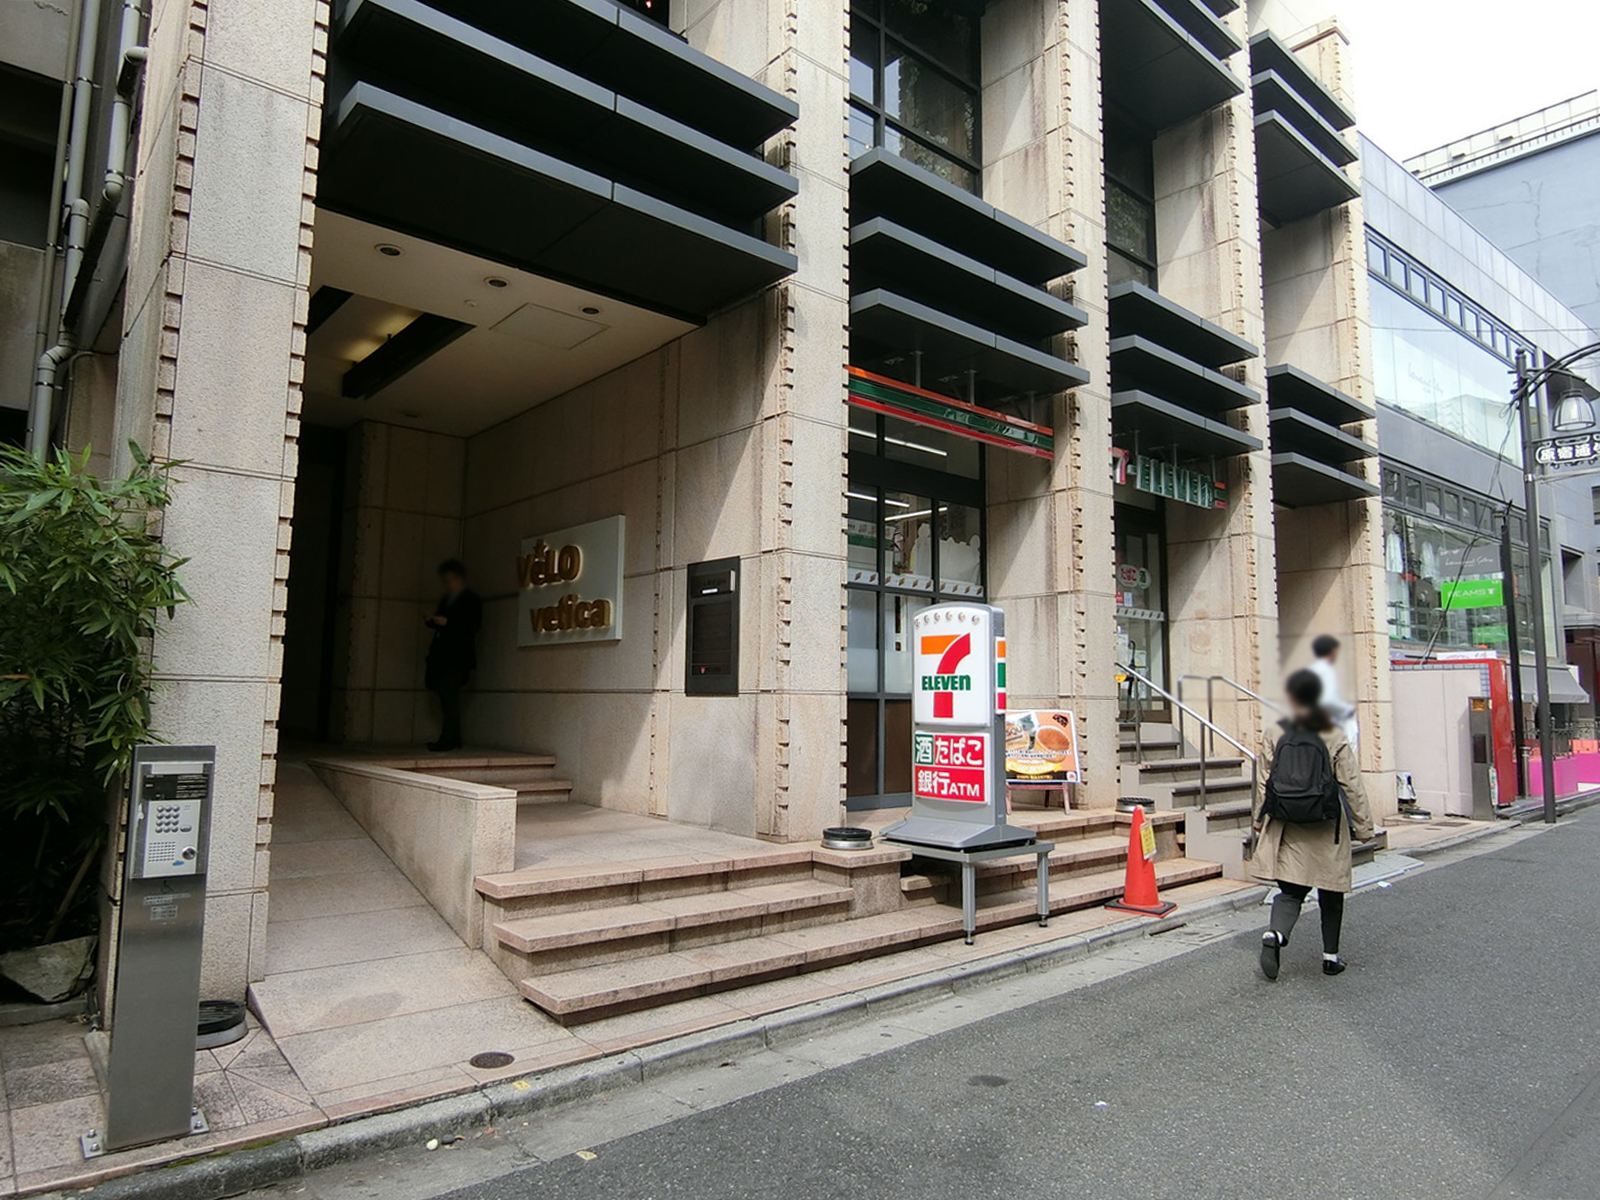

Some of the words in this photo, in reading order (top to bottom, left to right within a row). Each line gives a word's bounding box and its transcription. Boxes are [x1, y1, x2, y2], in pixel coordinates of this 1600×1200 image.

[915, 736, 933, 763] 酒
[935, 737, 983, 765] たばこ
